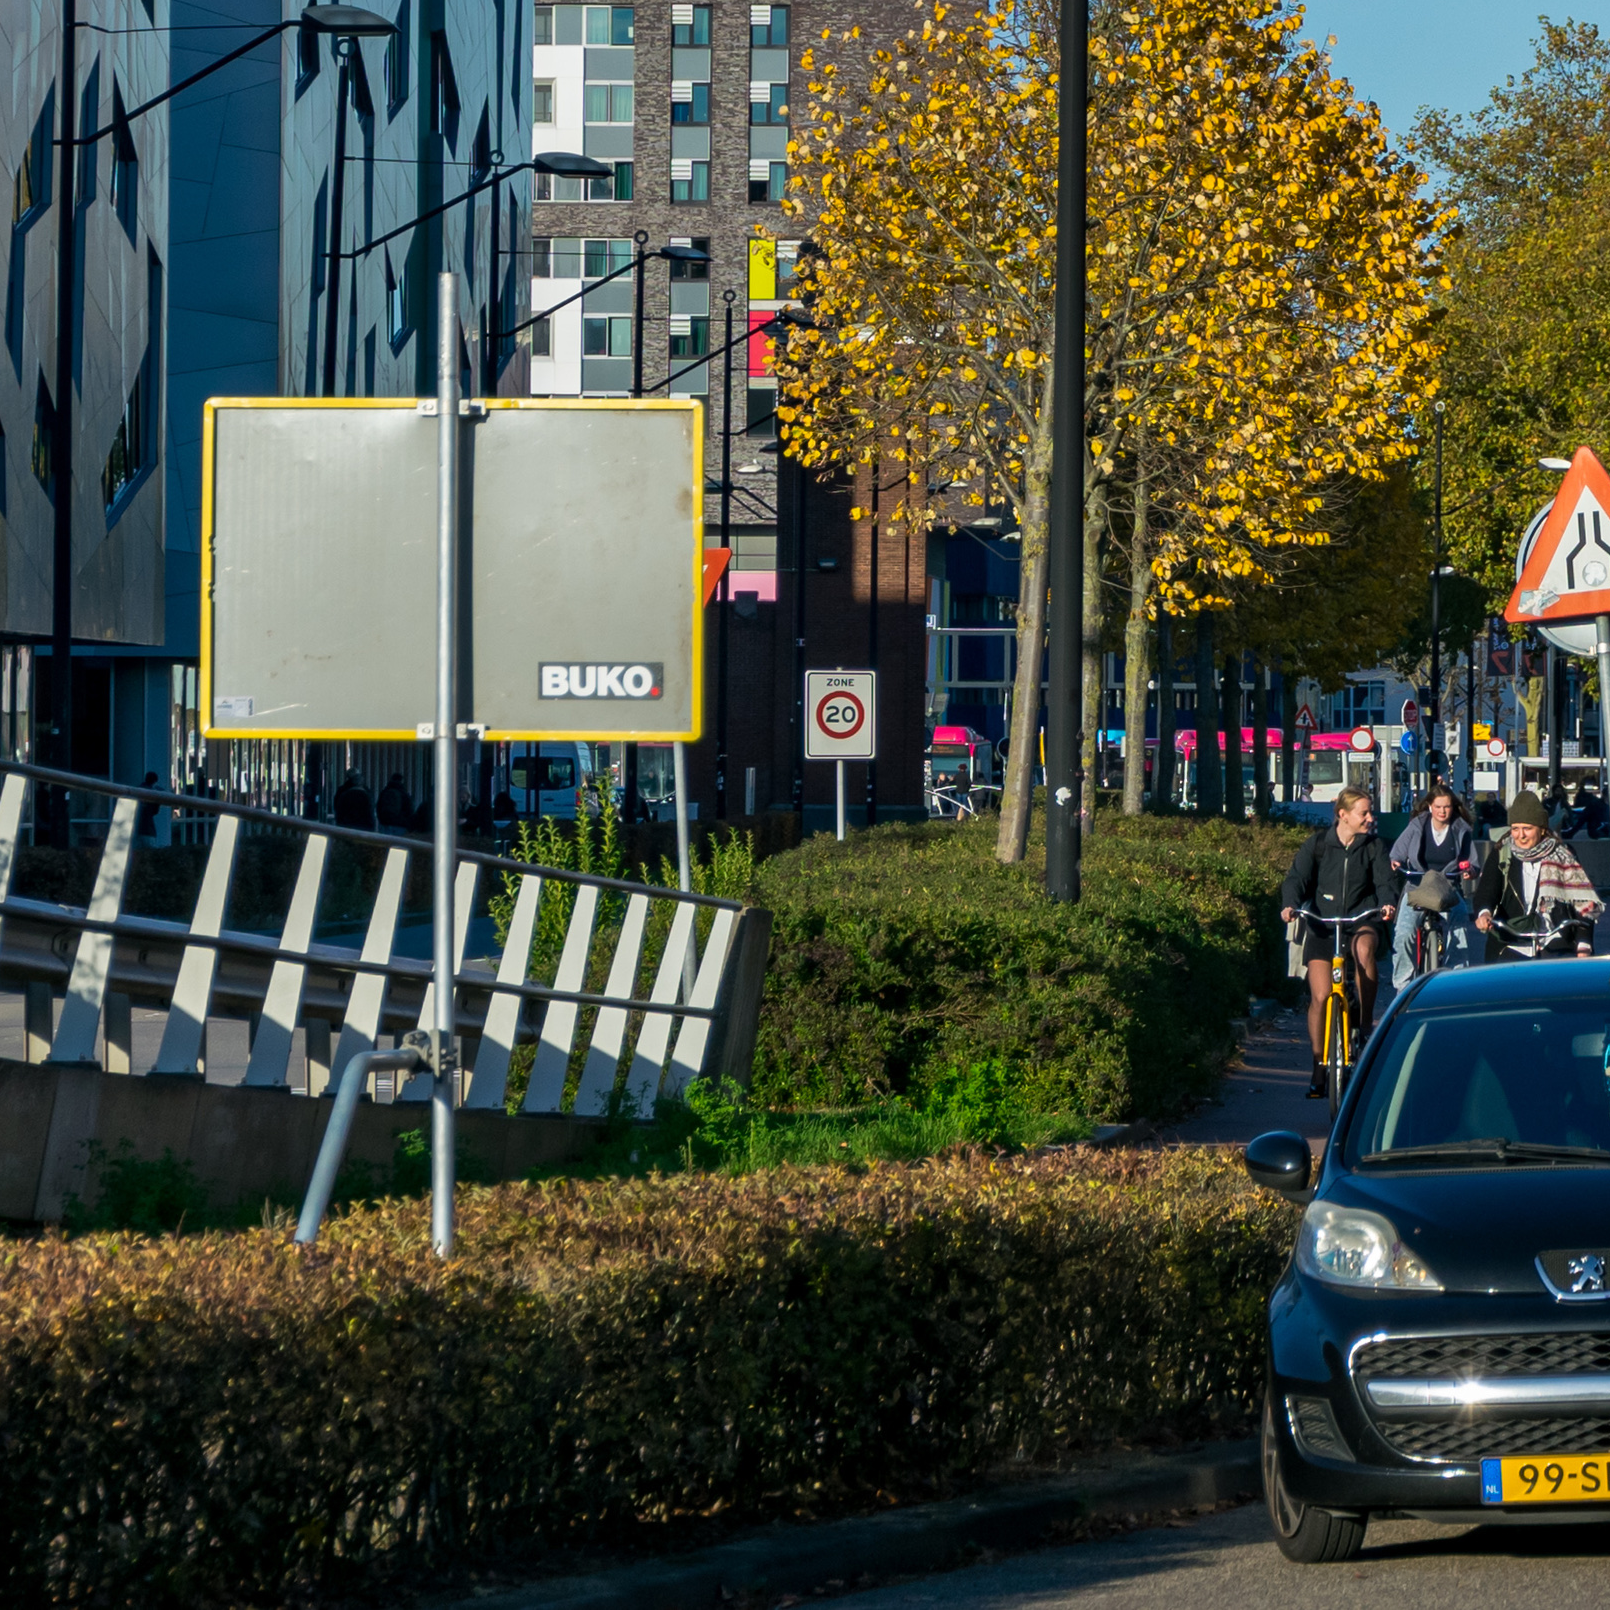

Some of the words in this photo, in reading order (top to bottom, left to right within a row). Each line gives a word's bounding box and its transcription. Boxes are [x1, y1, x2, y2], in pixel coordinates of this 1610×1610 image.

[826, 678, 854, 687] ZONE
[826, 706, 856, 723] 20
[1486, 1485, 1499, 1494] NL
